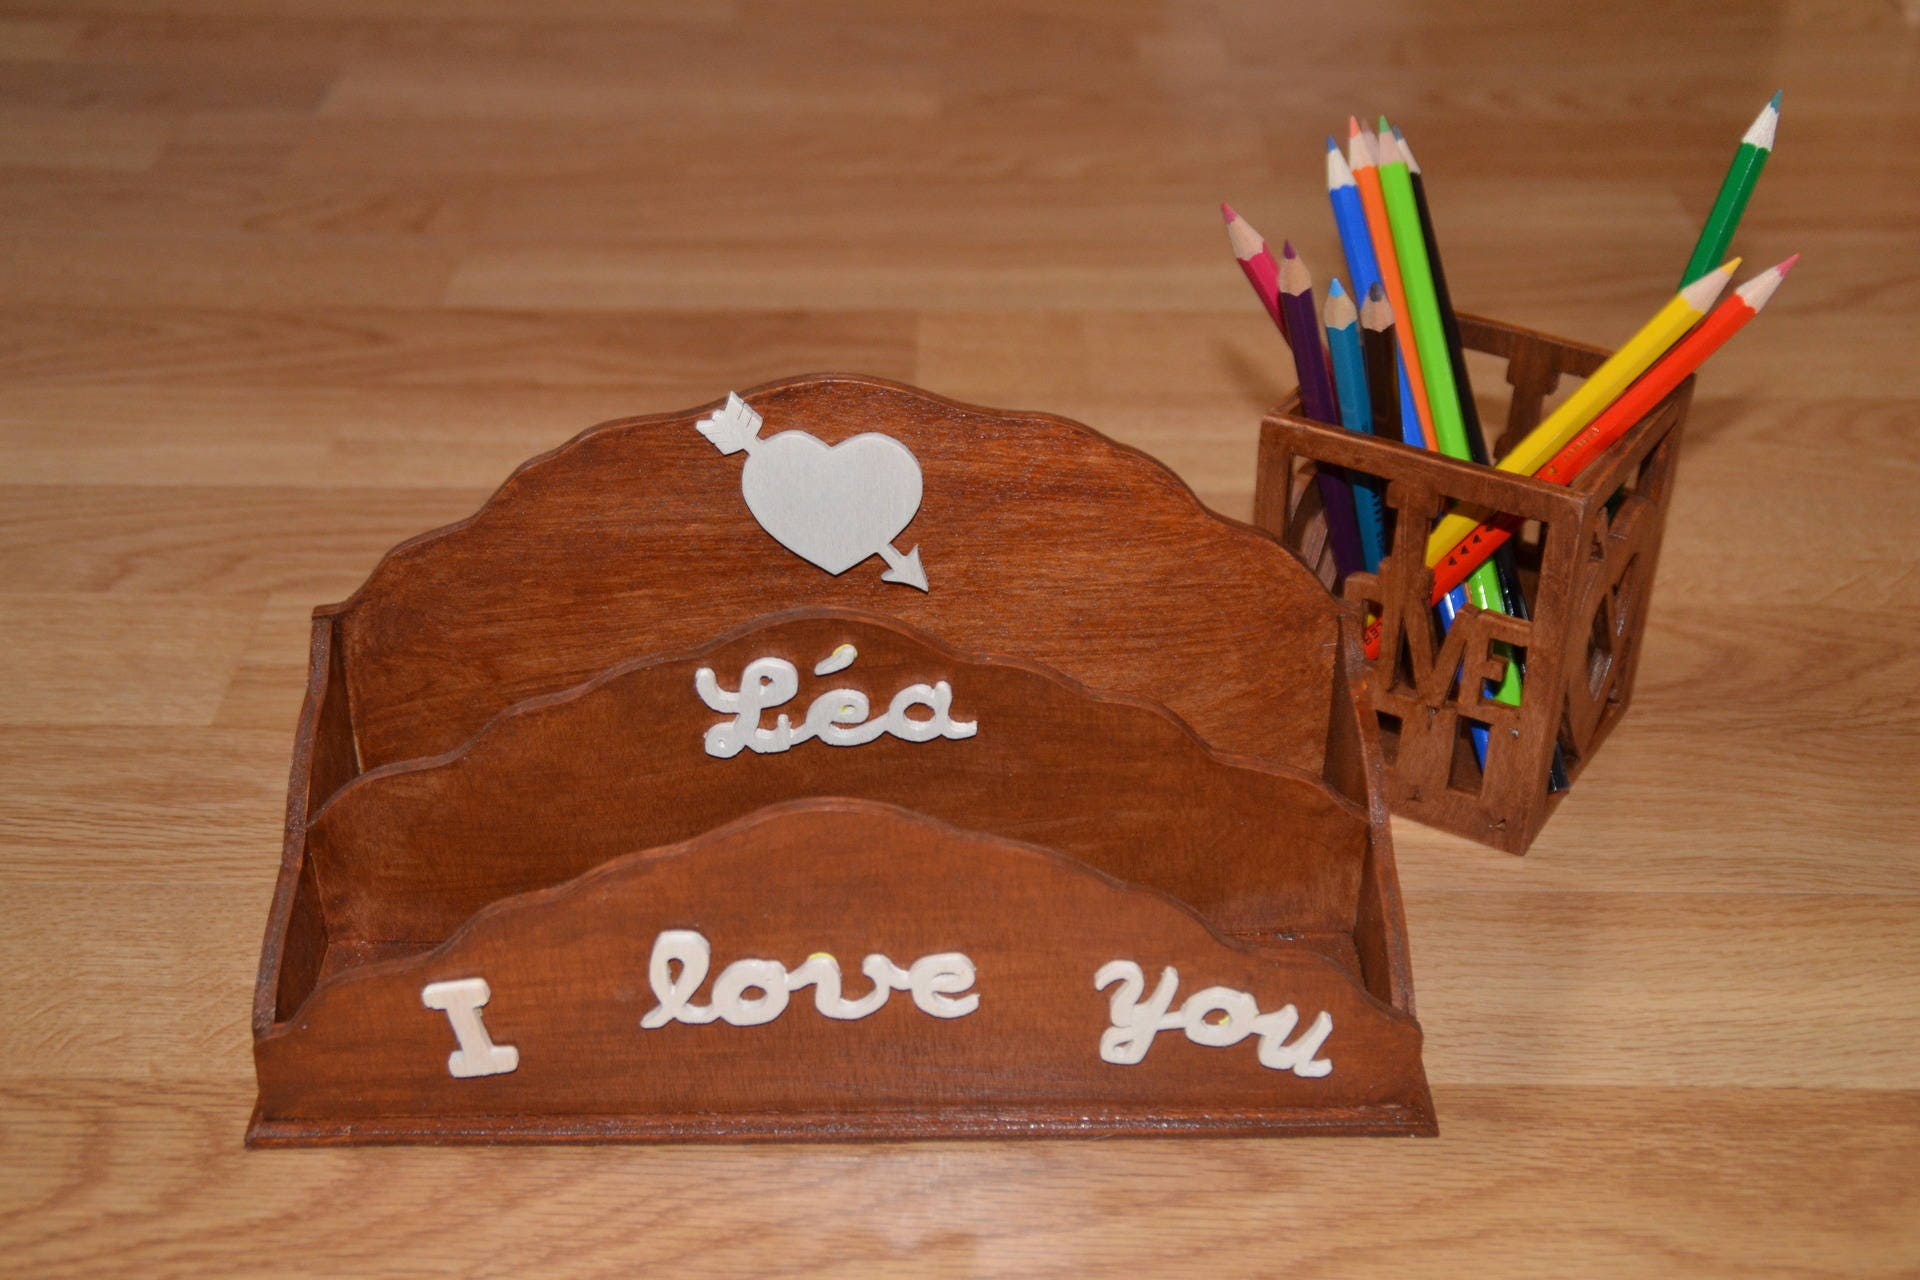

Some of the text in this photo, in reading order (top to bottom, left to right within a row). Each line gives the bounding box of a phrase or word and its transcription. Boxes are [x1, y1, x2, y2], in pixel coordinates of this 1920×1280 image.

[694, 644, 978, 759] Léa
[420, 929, 1334, 1078] I love you
